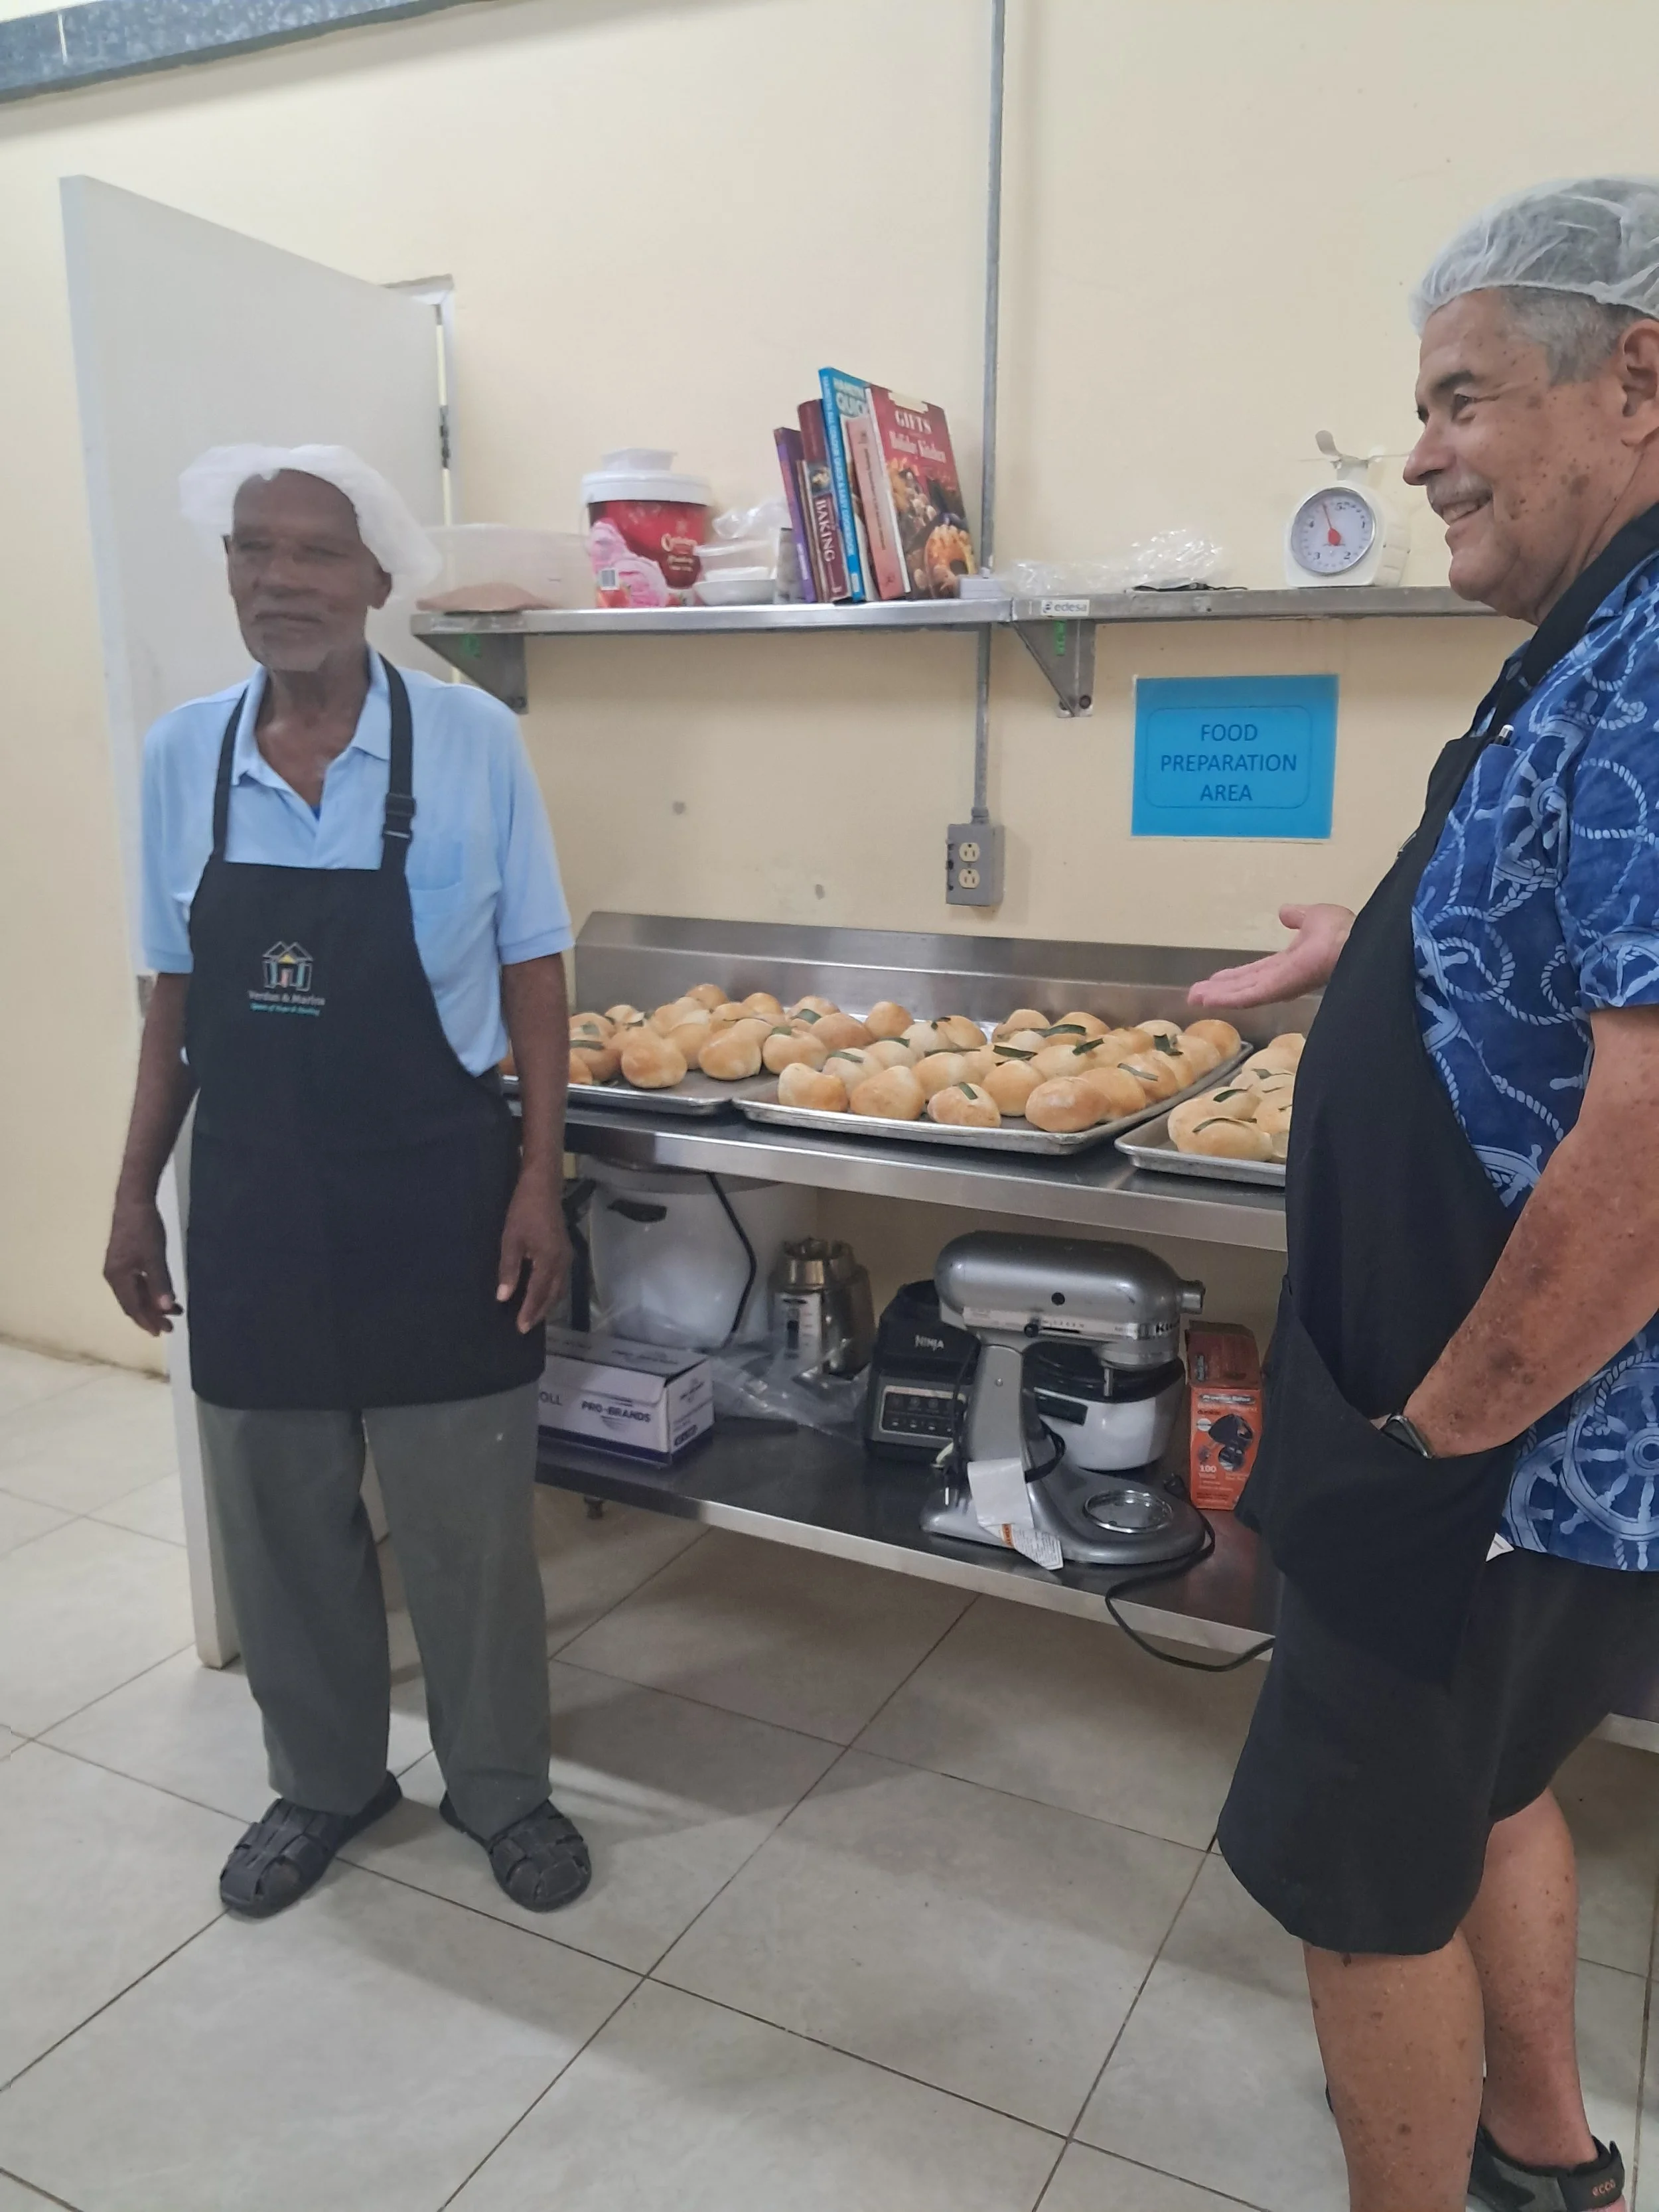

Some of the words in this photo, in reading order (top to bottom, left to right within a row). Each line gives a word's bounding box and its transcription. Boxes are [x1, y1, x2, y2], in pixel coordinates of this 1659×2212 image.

[895, 410, 932, 435] GIFTS
[816, 499, 835, 563] BAKING
[1200, 723, 1258, 742] FOOD
[1161, 754, 1297, 772] PREPARATION
[1199, 784, 1253, 802] AREA
